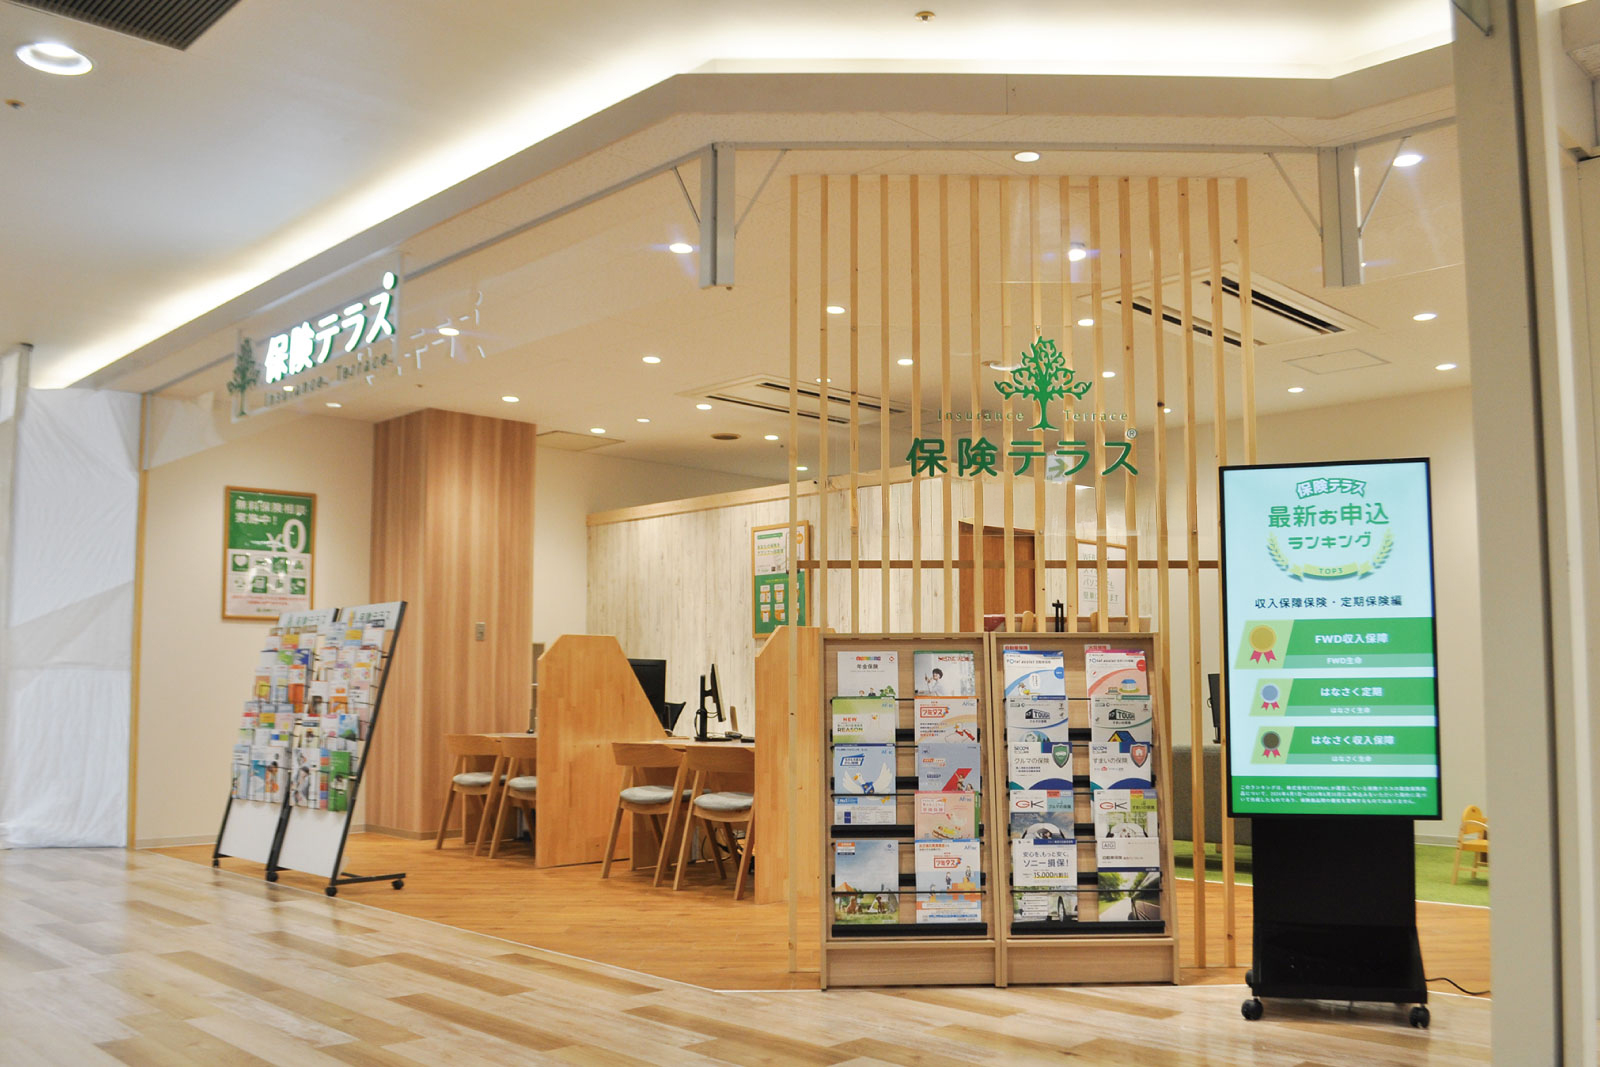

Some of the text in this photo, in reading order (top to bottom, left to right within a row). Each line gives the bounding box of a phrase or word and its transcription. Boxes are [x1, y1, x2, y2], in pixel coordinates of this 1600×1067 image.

[264, 291, 396, 384] 保険テラス
[937, 409, 1128, 421] Insurance Terrace
[905, 437, 1139, 478] 保険テラス
[1296, 478, 1367, 499] 保険テラス
[1268, 502, 1390, 528] 最新お申込
[1288, 531, 1372, 550] ランキング
[1319, 567, 1343, 575] TOP3
[1254, 595, 1403, 609] 収入保障保険・定期保険編
[1314, 633, 1390, 644] FWD収入保障
[1326, 656, 1363, 665] FWD生命
[1320, 687, 1383, 697] はなさく定期
[1311, 735, 1395, 745] はなさく収入保障
[1015, 800, 1044, 809] GK
[1099, 801, 1128, 810] GK
